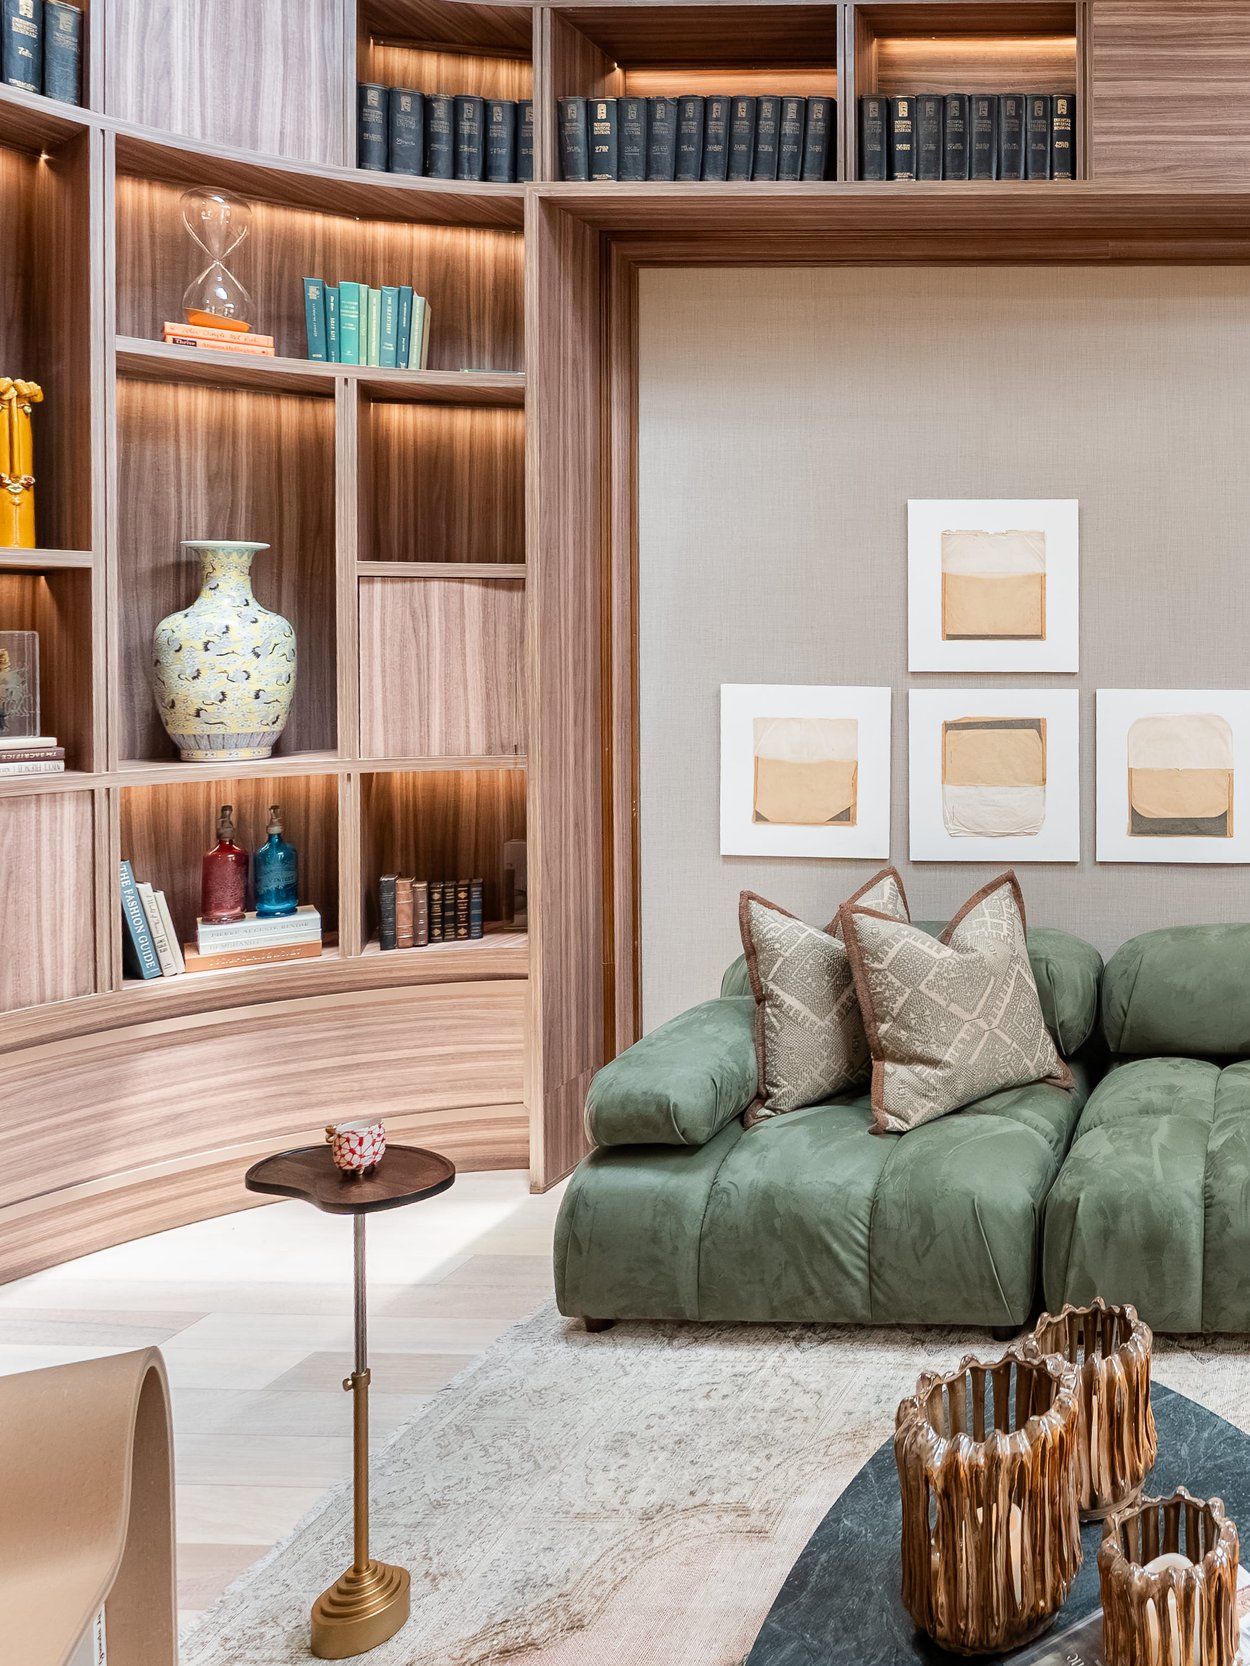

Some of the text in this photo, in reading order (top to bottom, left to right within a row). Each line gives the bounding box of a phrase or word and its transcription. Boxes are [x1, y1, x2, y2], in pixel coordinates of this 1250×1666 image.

[120, 866, 131, 888] THE
[123, 889, 145, 933] FASHION
[138, 935, 156, 968] GUIDE
